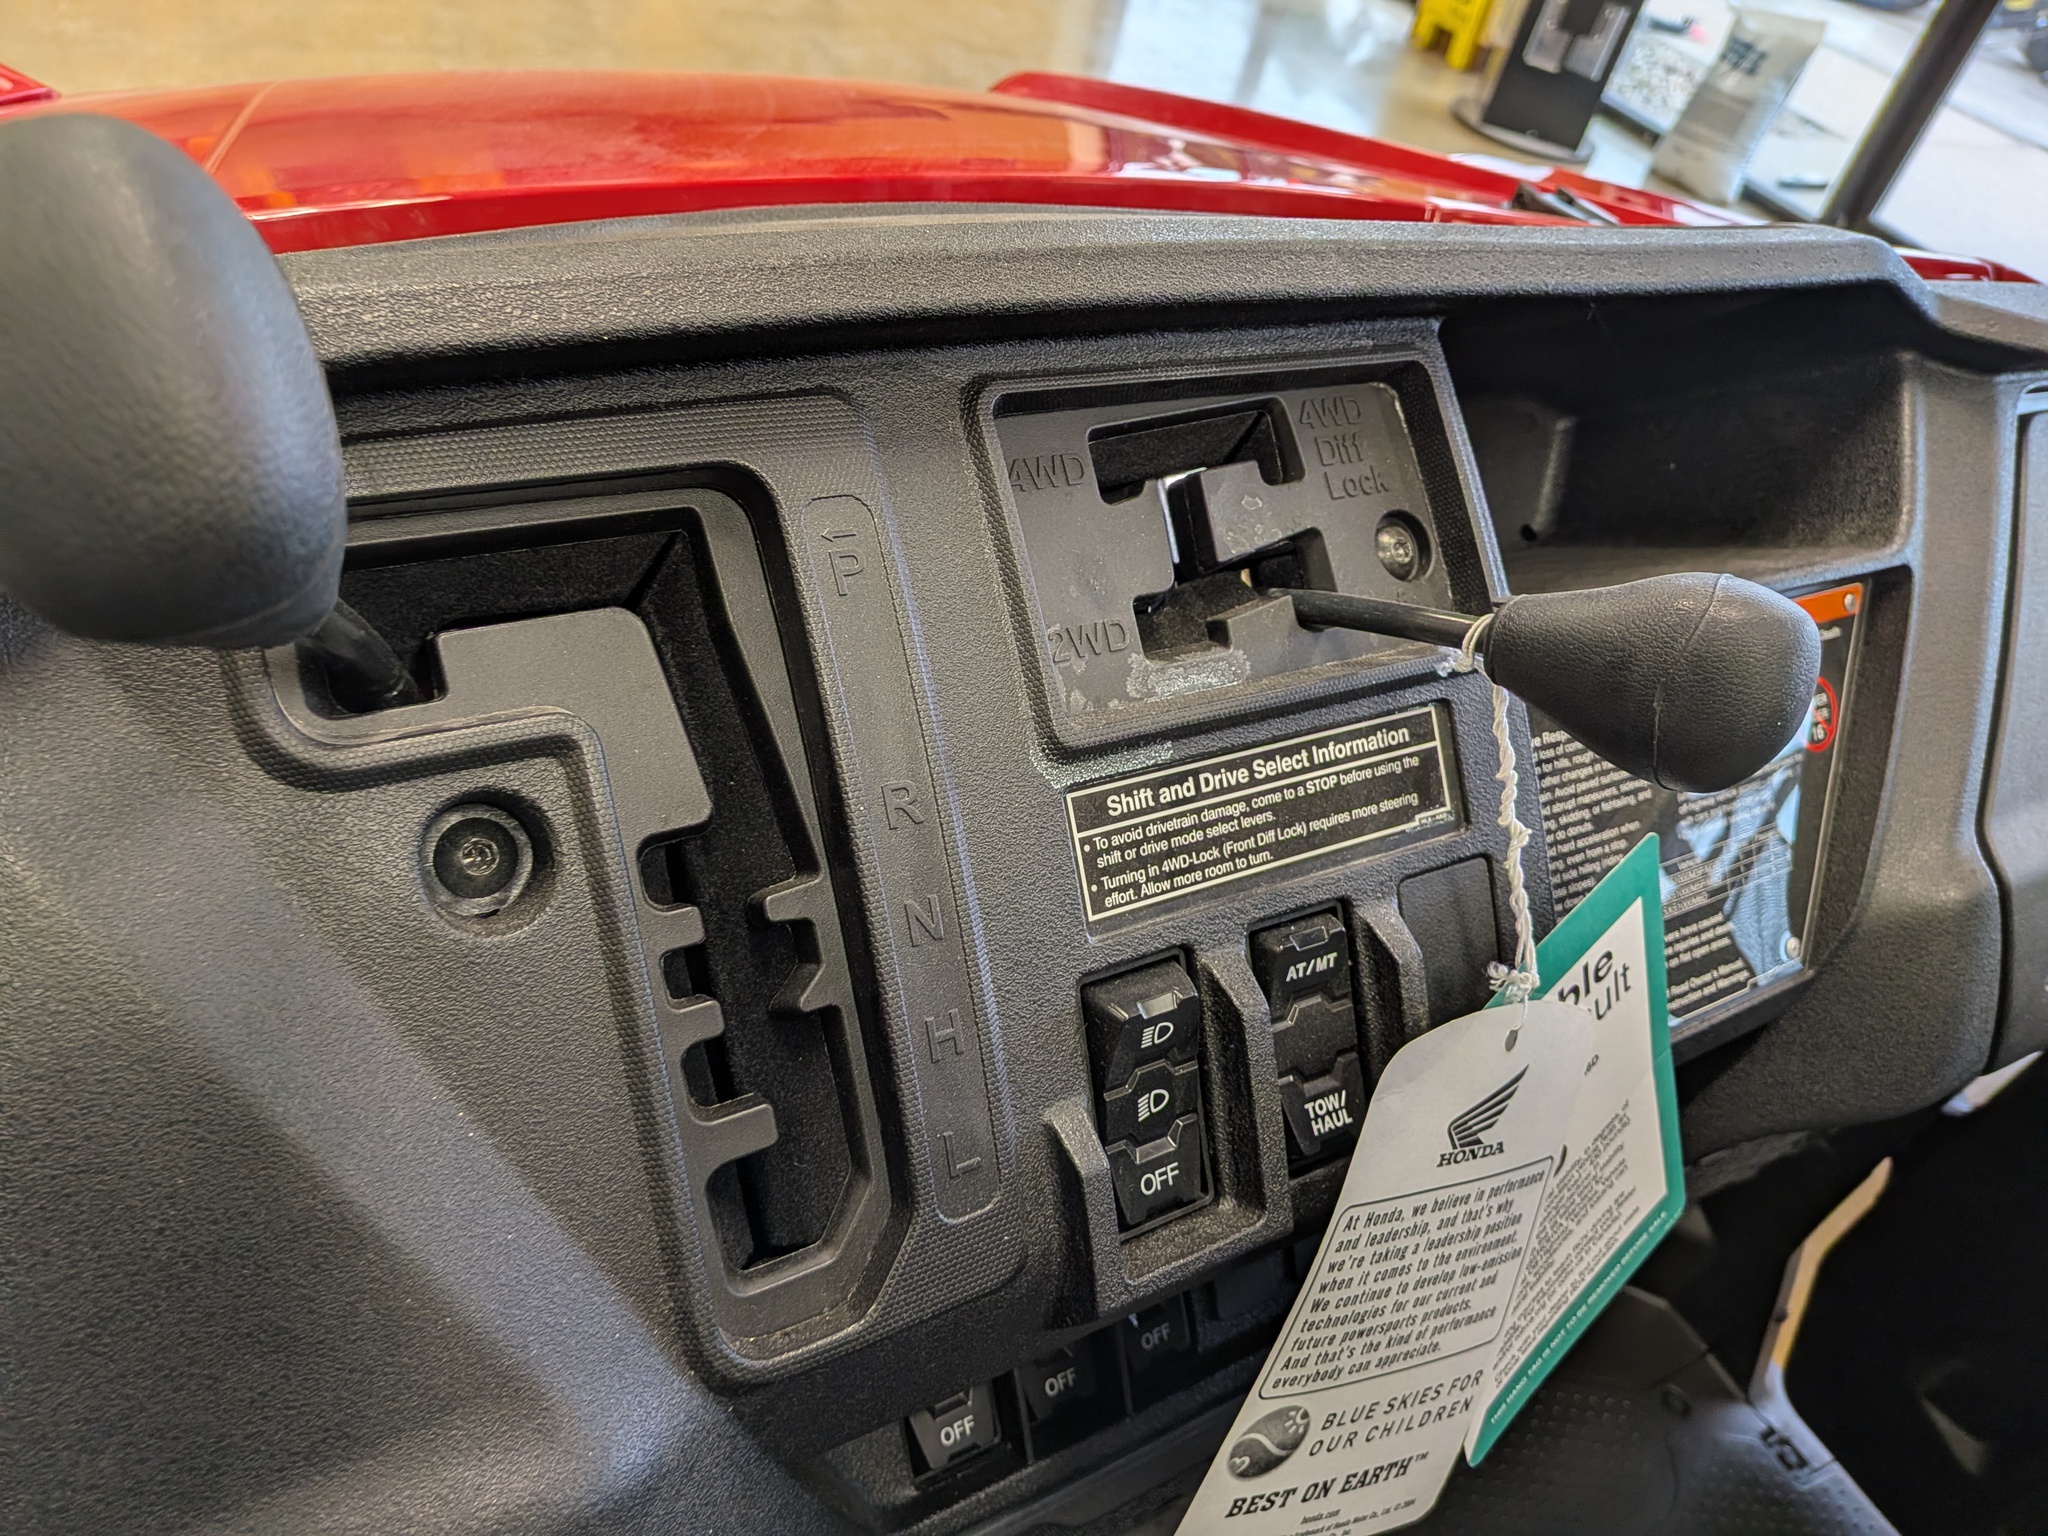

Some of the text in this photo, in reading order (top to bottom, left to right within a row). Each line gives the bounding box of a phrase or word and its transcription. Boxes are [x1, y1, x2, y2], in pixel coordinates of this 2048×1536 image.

[1299, 395, 1362, 430] 4WD
[1009, 452, 1085, 492] 4WD
[1315, 431, 1363, 467] Diff
[1325, 466, 1391, 501] Lock
[828, 550, 866, 596] P
[1050, 619, 1130, 664] 2WD
[1107, 727, 1410, 817] Shift and Drive Select Information
[881, 780, 924, 831] R
[1093, 754, 1420, 851] To avoid drivetrain damage, come to a STOP before using the
[1096, 808, 1277, 869] shift or drive mode select levers.
[1100, 791, 1419, 890] Turning in 4WD-Lock (Front Diff Lock) requires more steering
[1104, 849, 1274, 908] effort. Allow more room to turn.
[904, 894, 944, 947] N
[1286, 952, 1338, 983] AT/MT
[924, 1007, 965, 1064] H
[1304, 1090, 1347, 1119] TOW/
[1311, 1108, 1353, 1137] HAUL
[942, 1131, 982, 1179] L
[1140, 1162, 1180, 1196] OFF
[1436, 1141, 1505, 1168] HONDA
[1335, 1197, 1515, 1253] and leadership, and that's why
[1343, 1169, 1545, 1233] At Honda, we believe in performance
[1318, 1229, 1518, 1295] when it comes to the environment.
[1327, 1212, 1522, 1274] we're taking a leadership position
[1301, 1270, 1498, 1334] technologies for our current and
[1310, 1245, 1523, 1314] We continue to develop low-emission
[1140, 1321, 1171, 1350] OFF
[1280, 1305, 1497, 1371] And that's the kind of performance
[1290, 1297, 1472, 1352] future powersports products.
[1044, 1367, 1077, 1398] OFF
[1272, 1341, 1442, 1390] everybody can appreciate.
[1320, 1368, 1484, 1431] BLUE SKIES FOR
[940, 1414, 976, 1448] OFF
[1308, 1394, 1474, 1457] OUR CHILDREN
[1224, 1486, 1299, 1519] BEST
[1300, 1477, 1337, 1503] ON
[1300, 1508, 1341, 1525] honda.com
